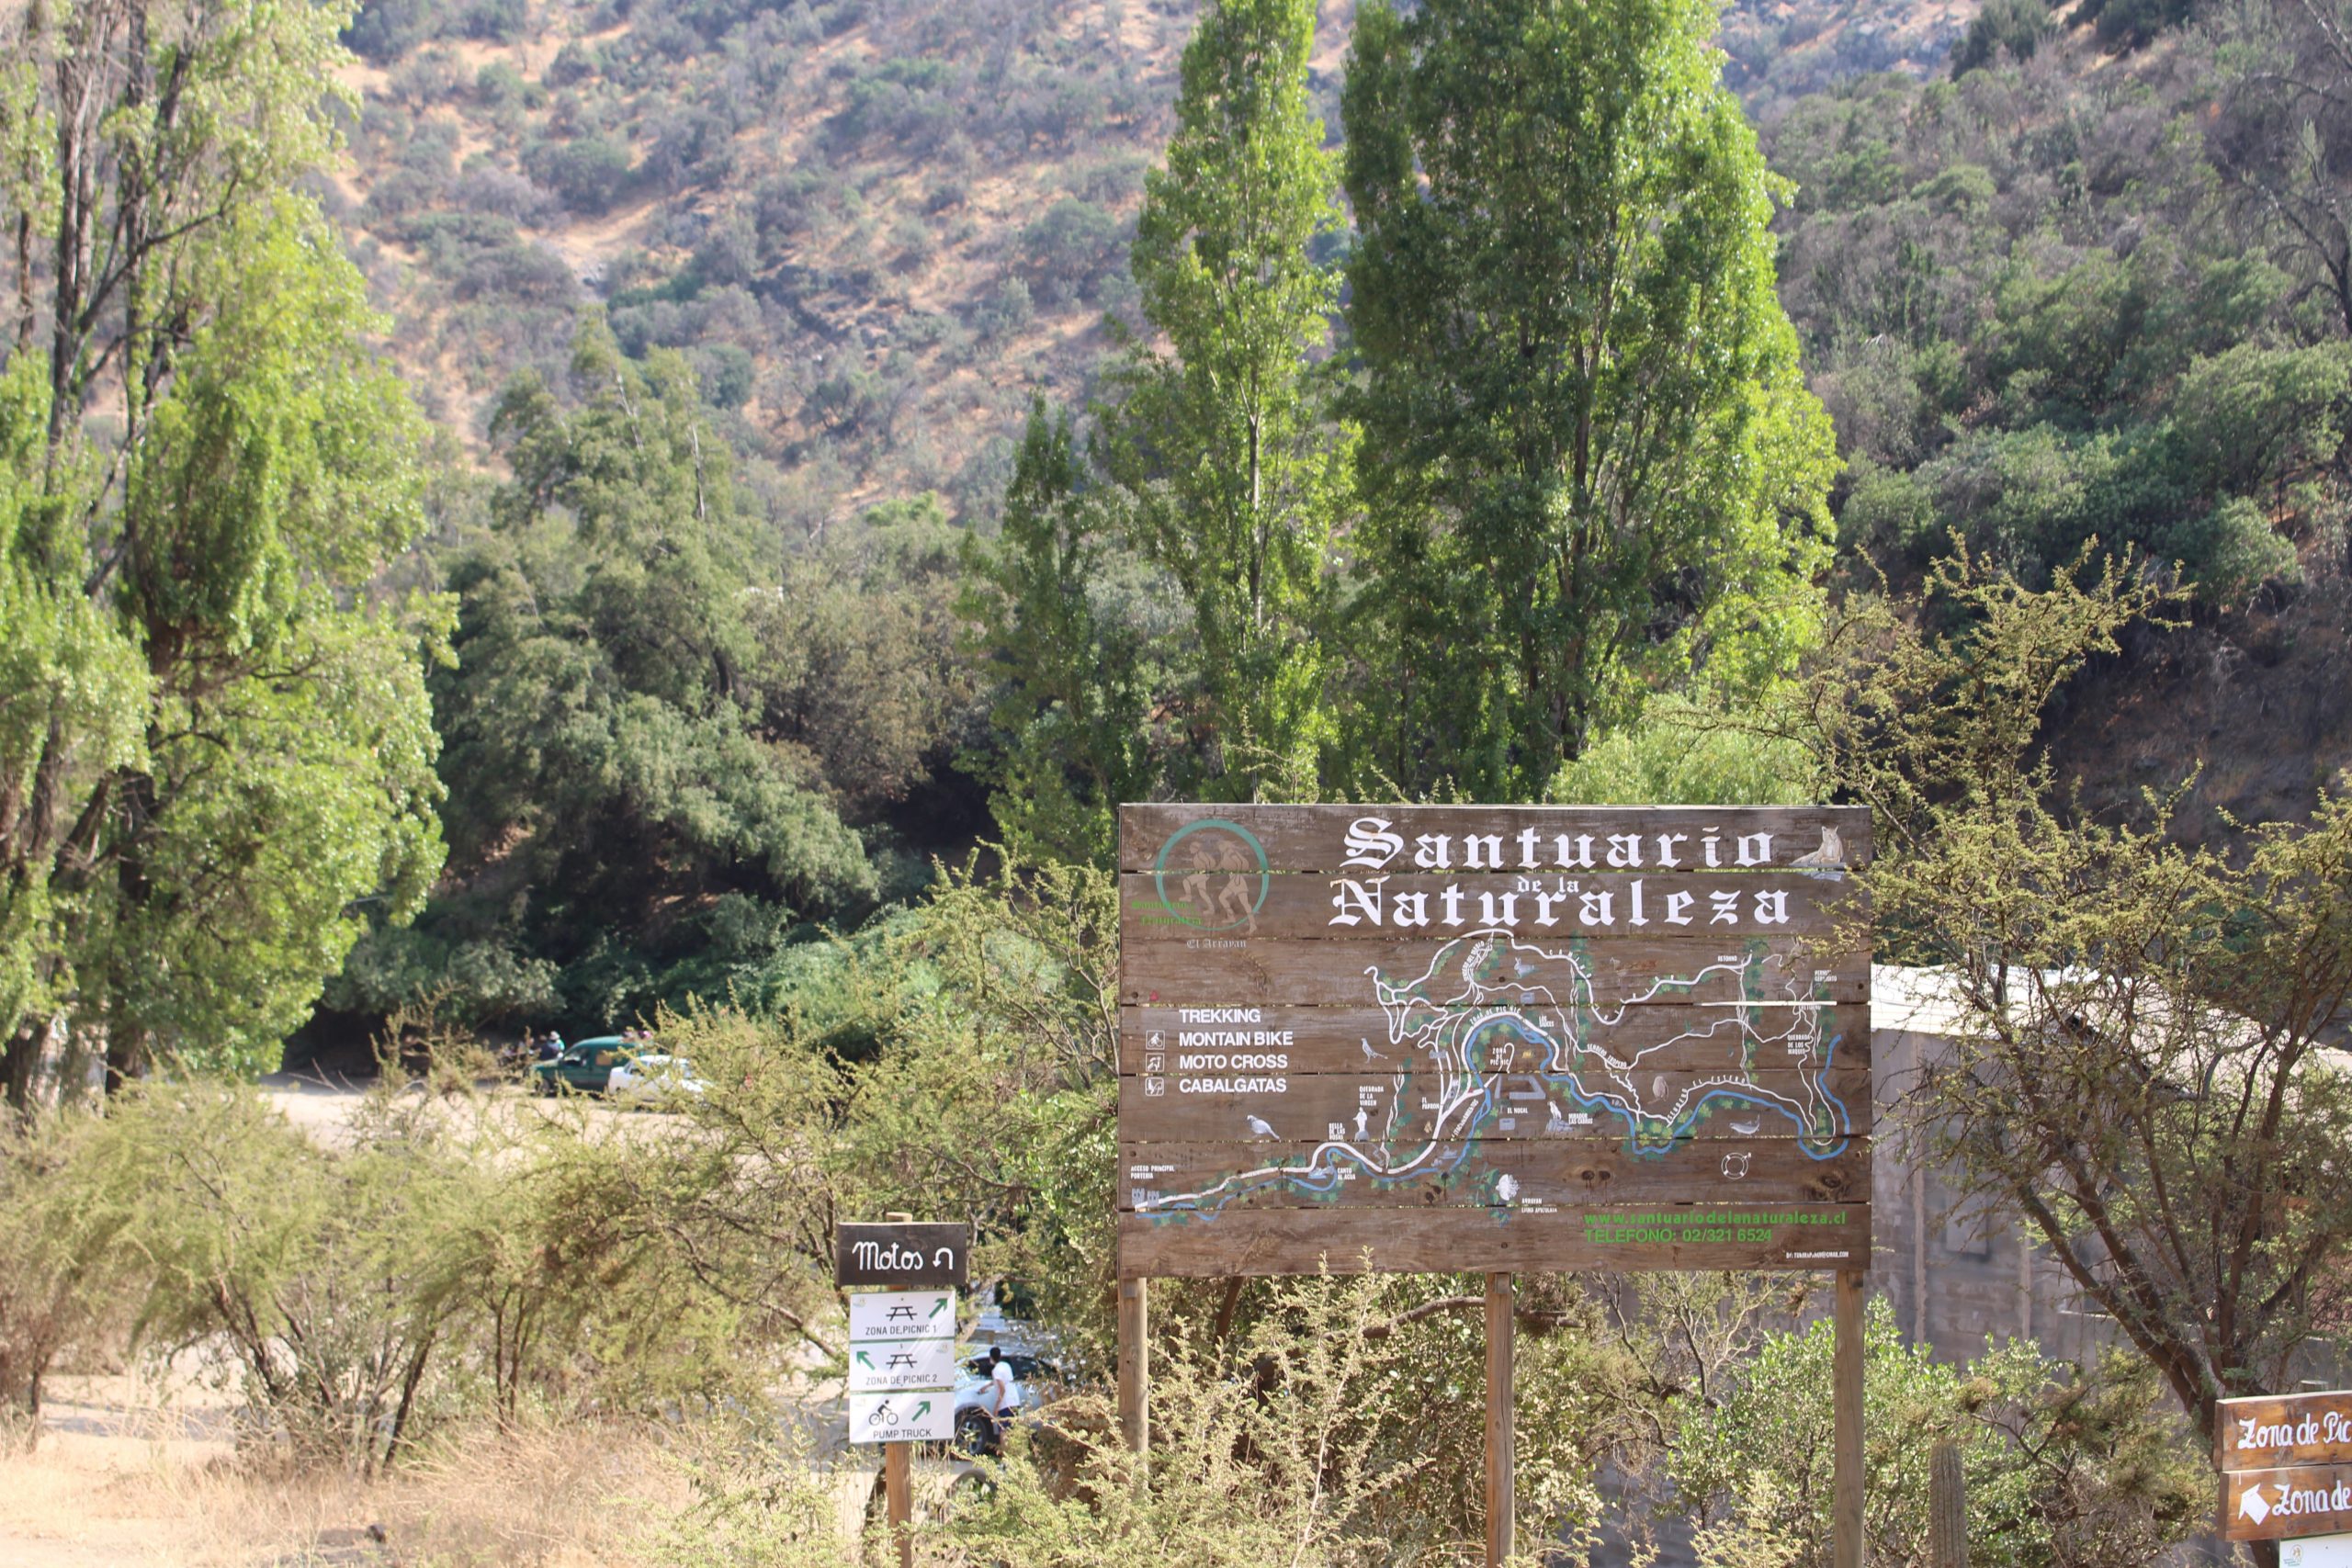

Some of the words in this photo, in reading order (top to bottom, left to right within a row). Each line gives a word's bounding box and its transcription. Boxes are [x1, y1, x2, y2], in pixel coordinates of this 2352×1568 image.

[1340, 817, 1774, 869] Santuario
[1517, 875, 1542, 893] de
[1559, 875, 1579, 893] la
[1329, 874, 1791, 927] Naturaleza
[1179, 1009, 1261, 1023] TREKKING
[1179, 1032, 1250, 1046] MONTAIN
[1254, 1031, 1294, 1045] BIKE
[1180, 1055, 1227, 1069] MOTO
[1231, 1054, 1288, 1069] CROSS
[1180, 1077, 1286, 1093] CABALGATAS
[1584, 1211, 1847, 1225] www.santuariodelanaturaleza.cl
[1584, 1228, 1677, 1243] TELEFONO:
[1682, 1227, 1732, 1242] 02/321
[1737, 1226, 1772, 1241] 6524
[853, 1241, 924, 1270] Motos
[865, 1326, 888, 1336] ZONA
[889, 1325, 900, 1335] DE
[902, 1325, 930, 1334] PICNIC
[933, 1325, 937, 1333] 1
[865, 1376, 888, 1385] ZONA
[890, 1375, 900, 1384] DE
[903, 1374, 930, 1383] PICNIC
[933, 1374, 937, 1382] 2
[873, 1430, 899, 1439] PUMP
[902, 1428, 932, 1438] TRUCK
[2238, 1417, 2294, 1450] Zona
[2296, 1413, 2320, 1446] de
[2272, 1483, 2331, 1517] Zona
[2331, 1480, 2352, 1511] de
